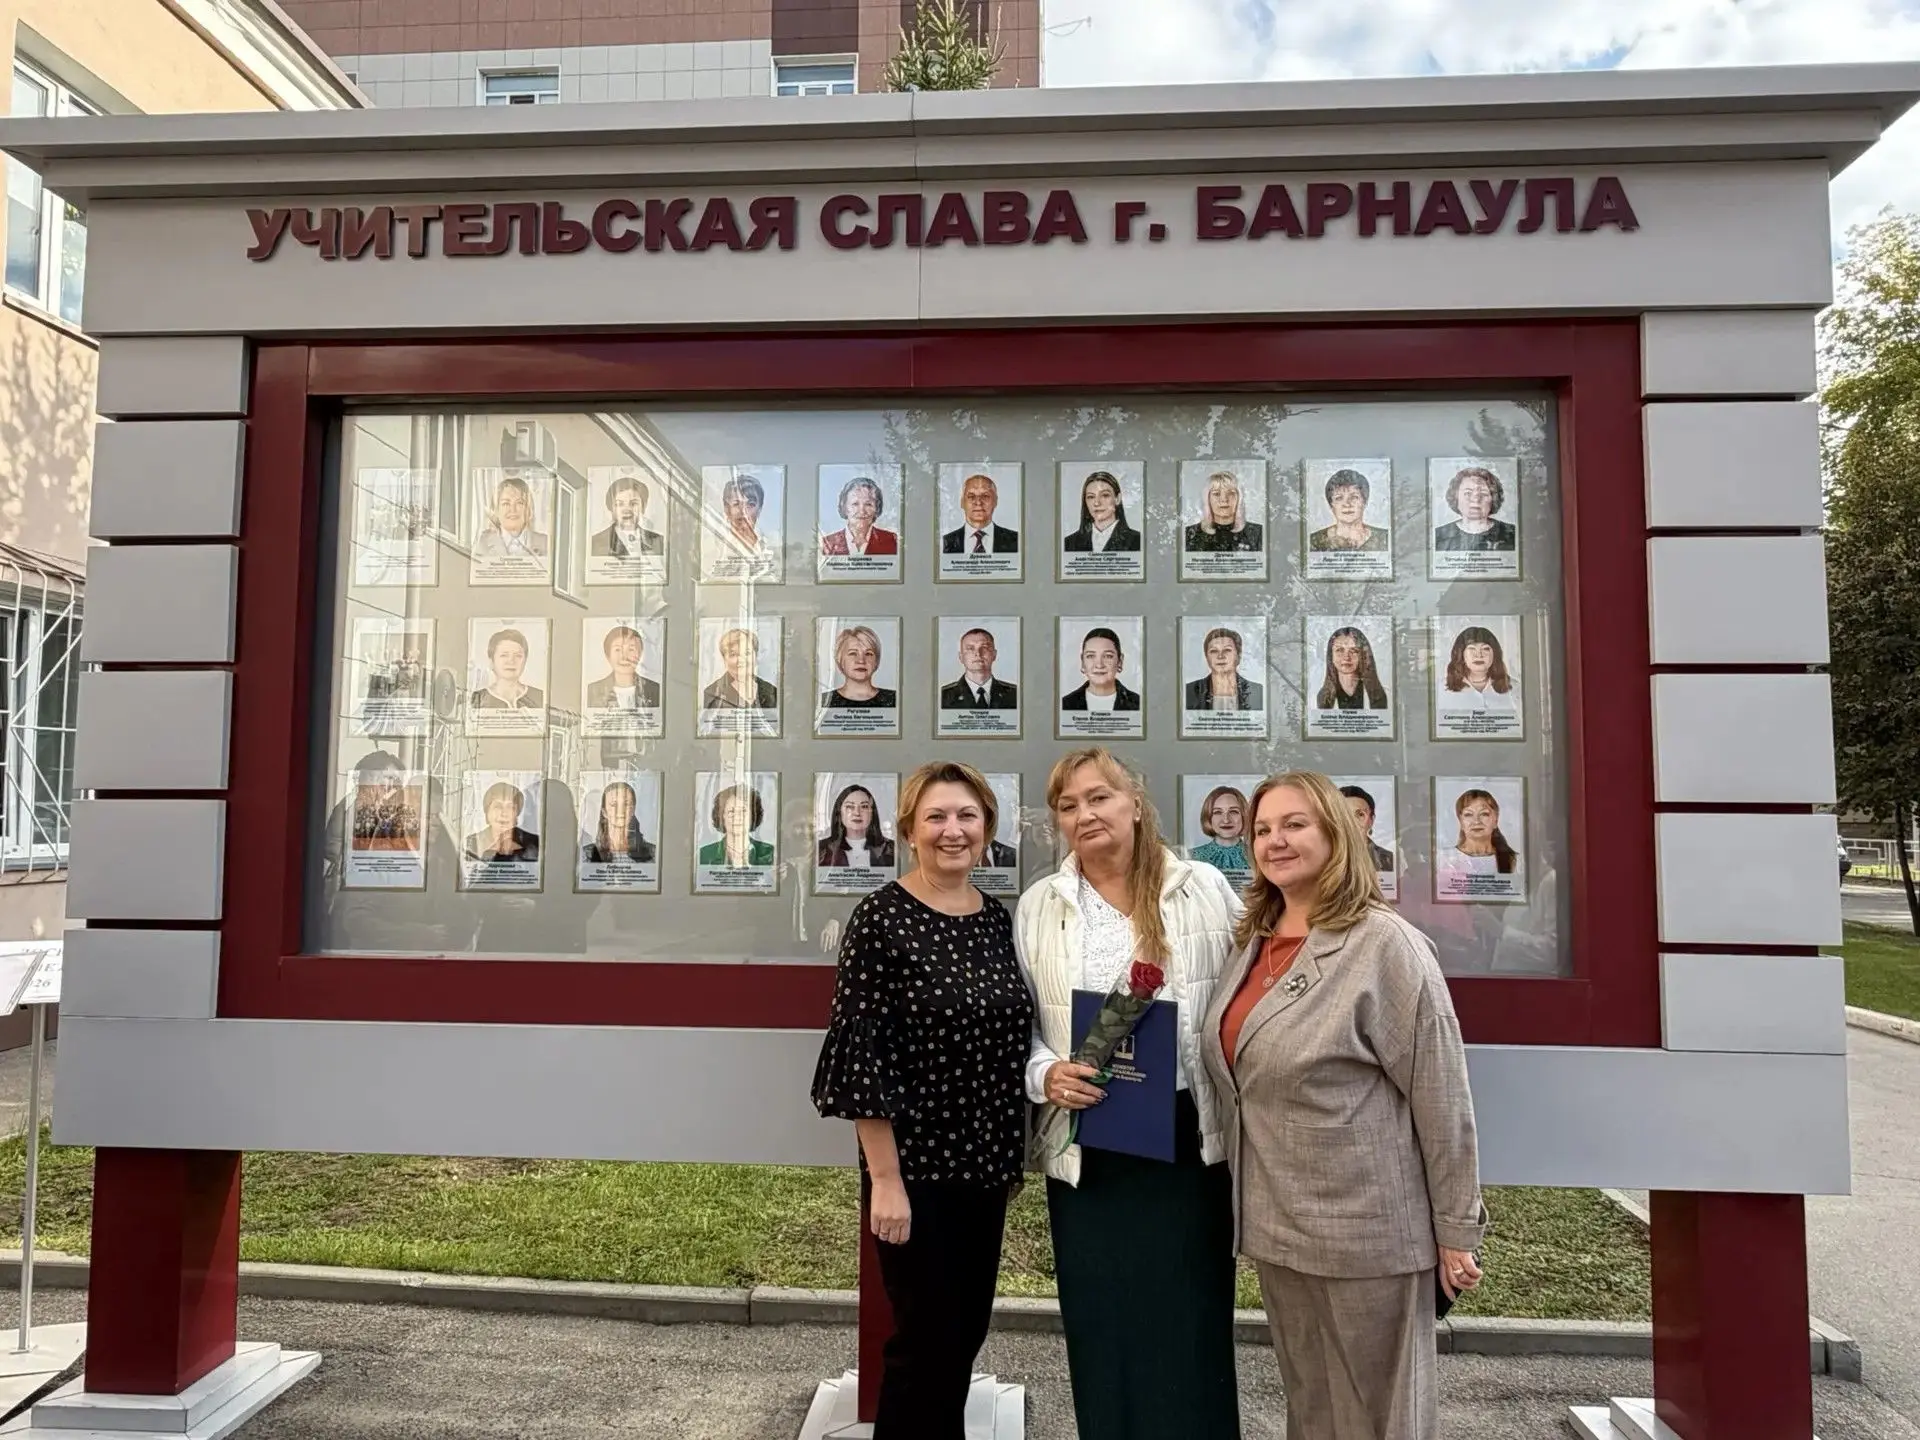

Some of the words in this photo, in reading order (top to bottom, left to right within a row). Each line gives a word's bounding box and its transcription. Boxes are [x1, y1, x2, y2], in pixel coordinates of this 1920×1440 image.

[246, 196, 796, 260] УЧИТЕЛЬСКАЯ
[818, 190, 1088, 249] СЛАВА
[1114, 201, 1167, 242] г.
[1196, 176, 1641, 241] БАРНАУЛА
